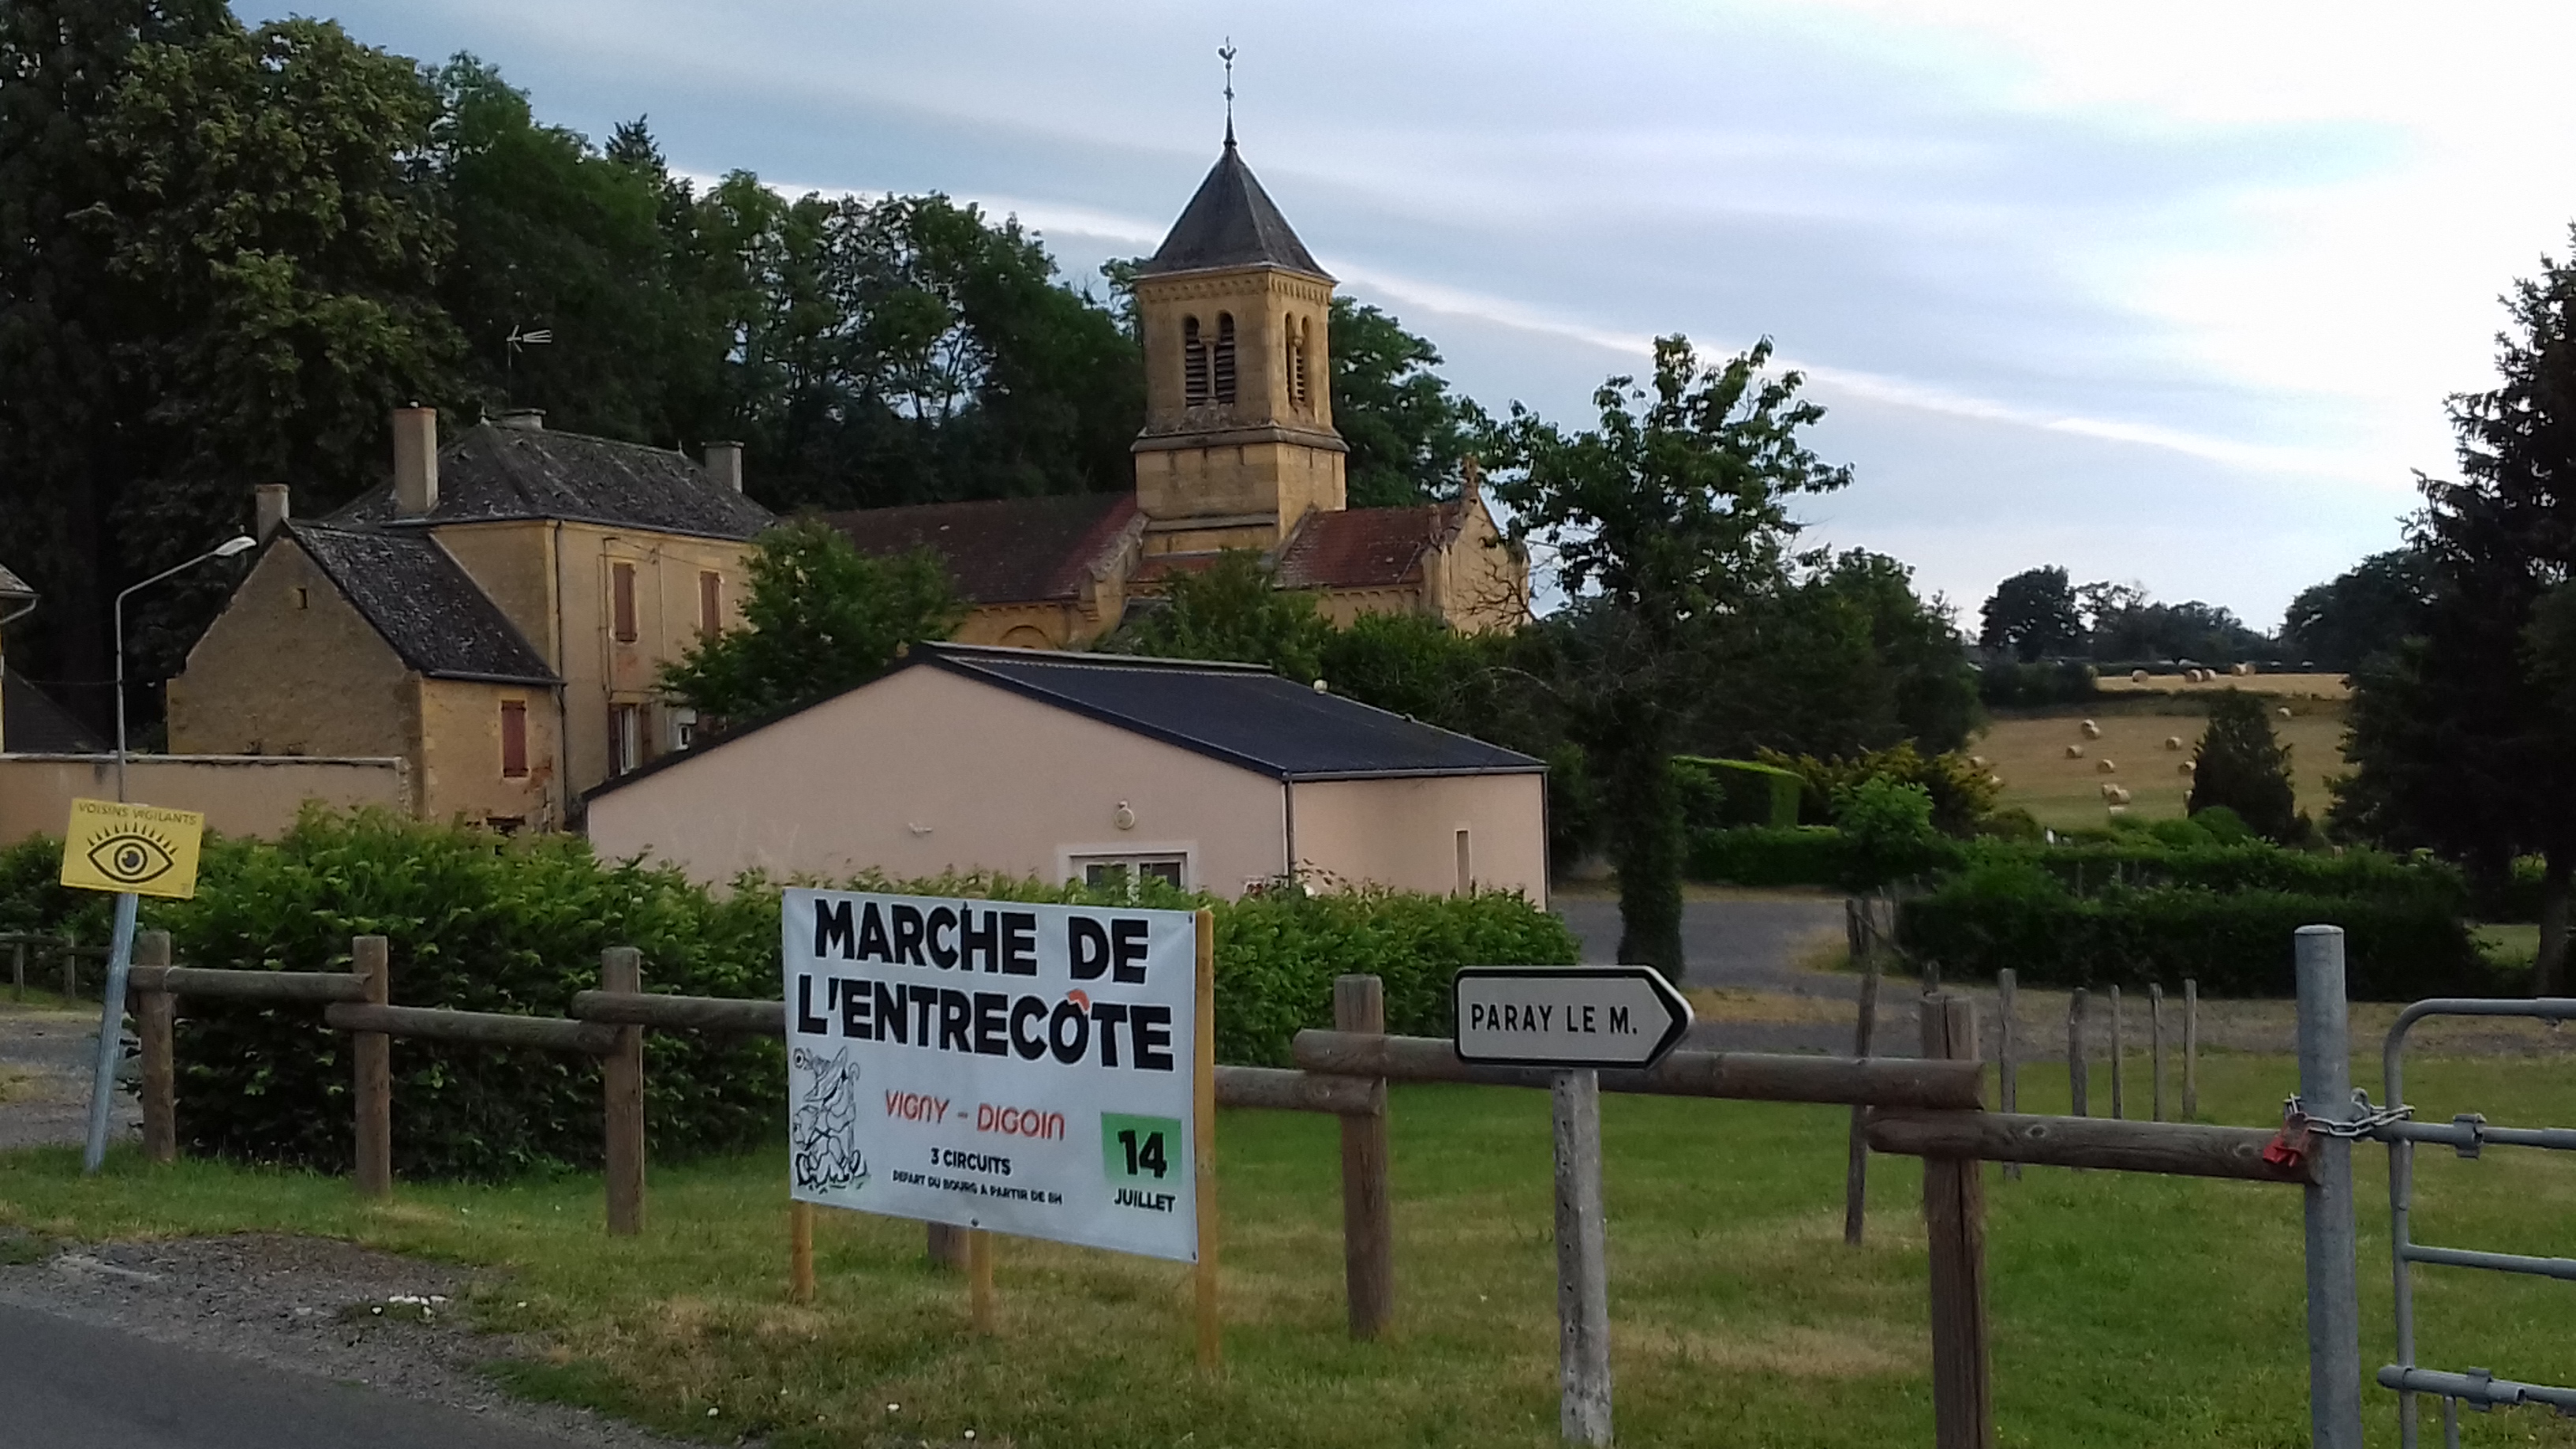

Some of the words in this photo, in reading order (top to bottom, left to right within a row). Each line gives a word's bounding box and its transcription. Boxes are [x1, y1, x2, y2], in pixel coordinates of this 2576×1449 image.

[79, 803, 129, 816] VOISINS
[132, 808, 197, 826] VIGILANTS
[814, 899, 1038, 977] MARCHE
[1068, 916, 1149, 984] DE
[1470, 1003, 1552, 1032] PARAY
[1567, 1005, 1596, 1034] LE
[1609, 1005, 1638, 1035] M.
[885, 1088, 950, 1124] VIGNY
[930, 1147, 940, 1166] 3
[943, 1148, 1012, 1177] CIRCUITS
[1118, 1129, 1168, 1179] 14
[927, 1175, 941, 1189] DU
[943, 1179, 978, 1195] BOURG
[990, 1185, 1028, 1201] PARTIR
[1031, 1189, 1046, 1203] DE
[1114, 1188, 1176, 1213] JUILLET
